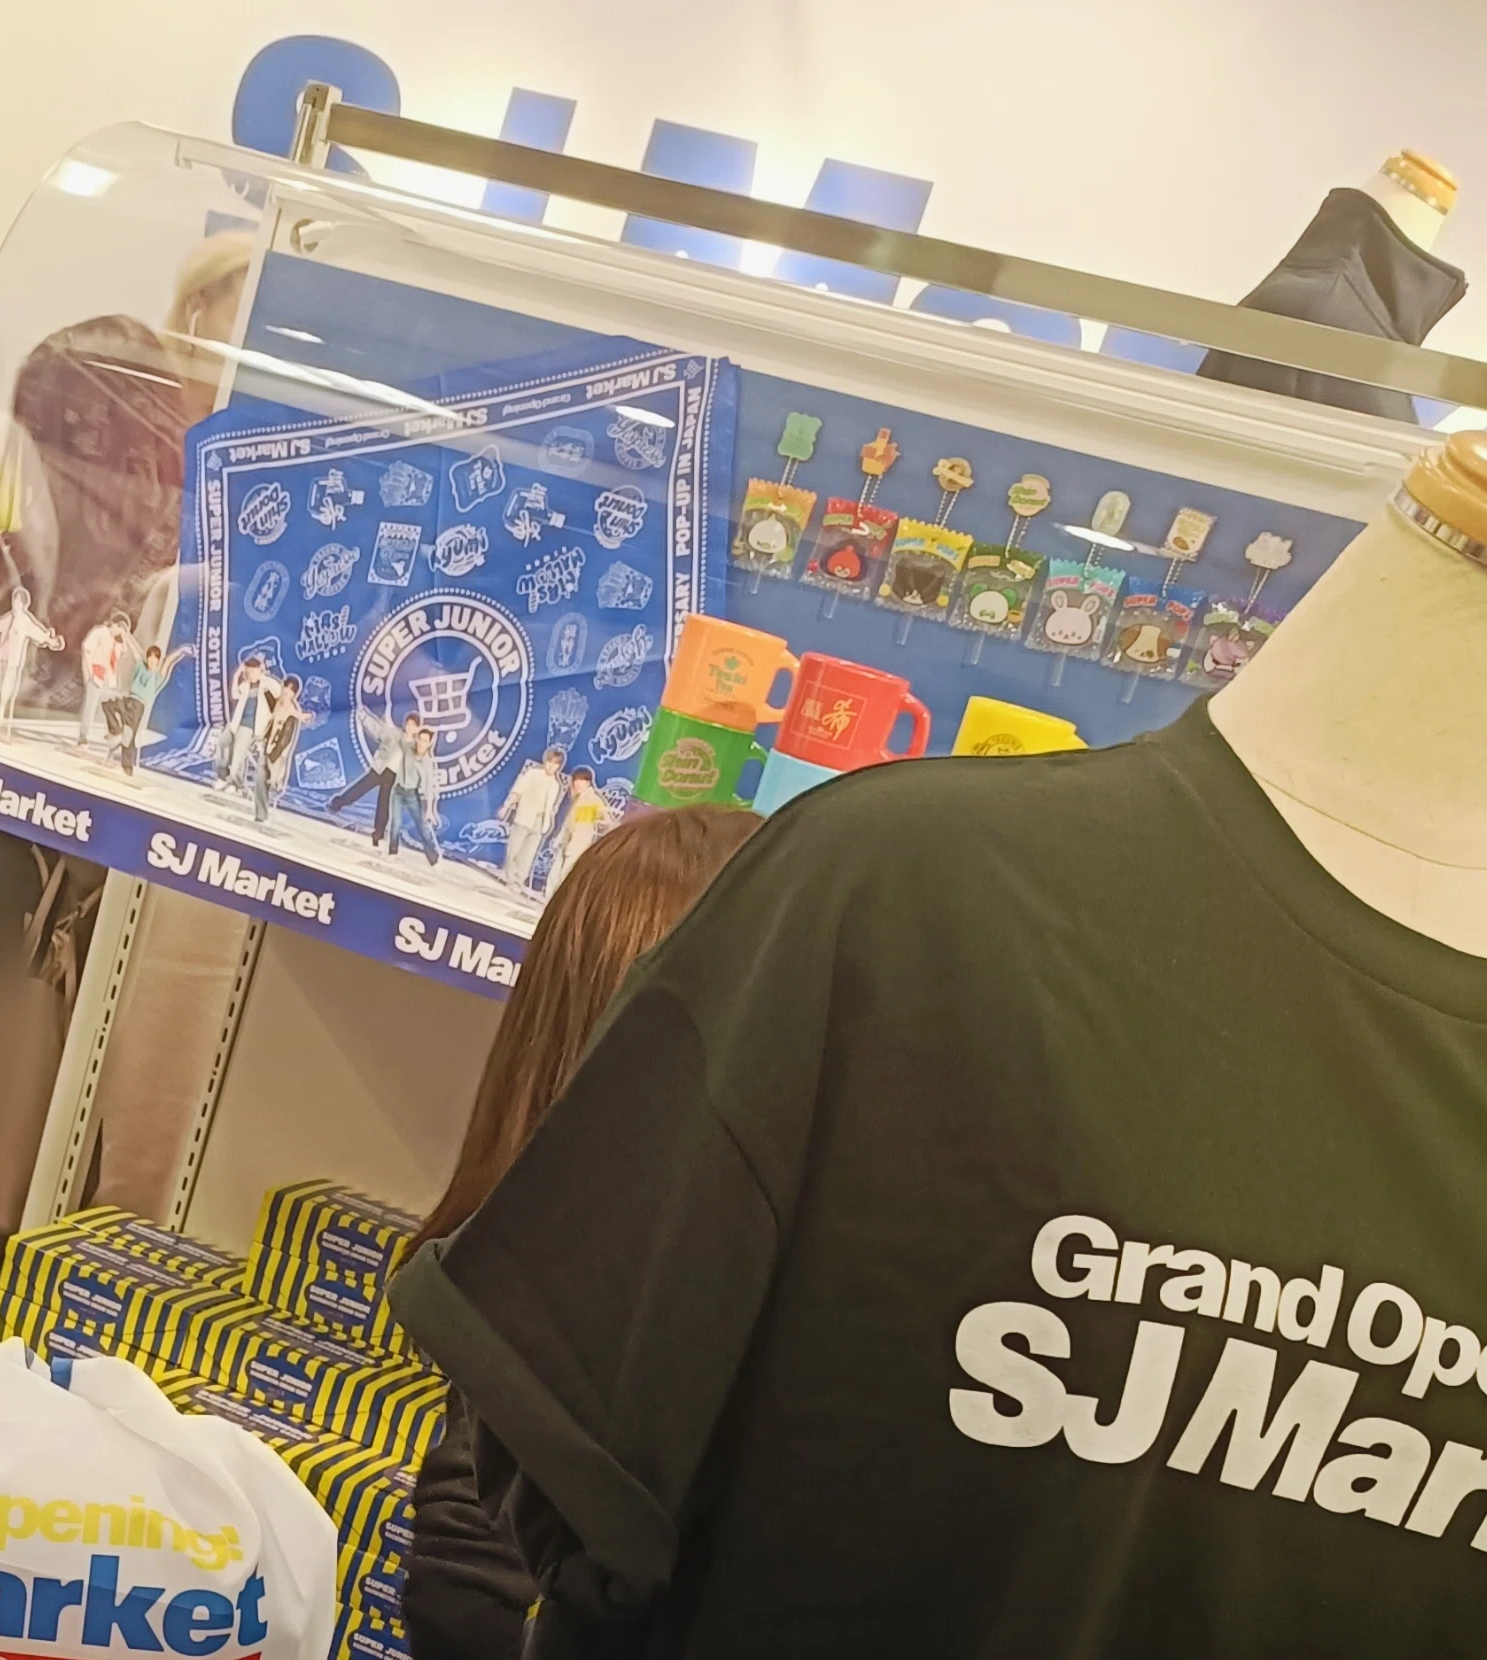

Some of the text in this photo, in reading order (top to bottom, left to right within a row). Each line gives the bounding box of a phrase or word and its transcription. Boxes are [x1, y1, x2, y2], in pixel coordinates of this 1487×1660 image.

[586, 364, 677, 400] SJ Market
[228, 438, 312, 463] SJ Market
[685, 387, 701, 451] JAPAN
[676, 453, 693, 476] IN
[206, 478, 223, 541] SUPER
[674, 481, 692, 558] POP-UP
[208, 544, 224, 612] JUNIOR
[364, 606, 433, 696] SUPER
[434, 604, 521, 678] JUNIOR
[433, 727, 508, 788] arket
[147, 832, 335, 925] SJ Market
[394, 916, 445, 961] SJ
[1030, 1214, 1345, 1349] Grand
[948, 1301, 1487, 1553] SJ Mar
[365, 1575, 397, 1594] SUPER
[353, 1632, 385, 1652] SUPER
